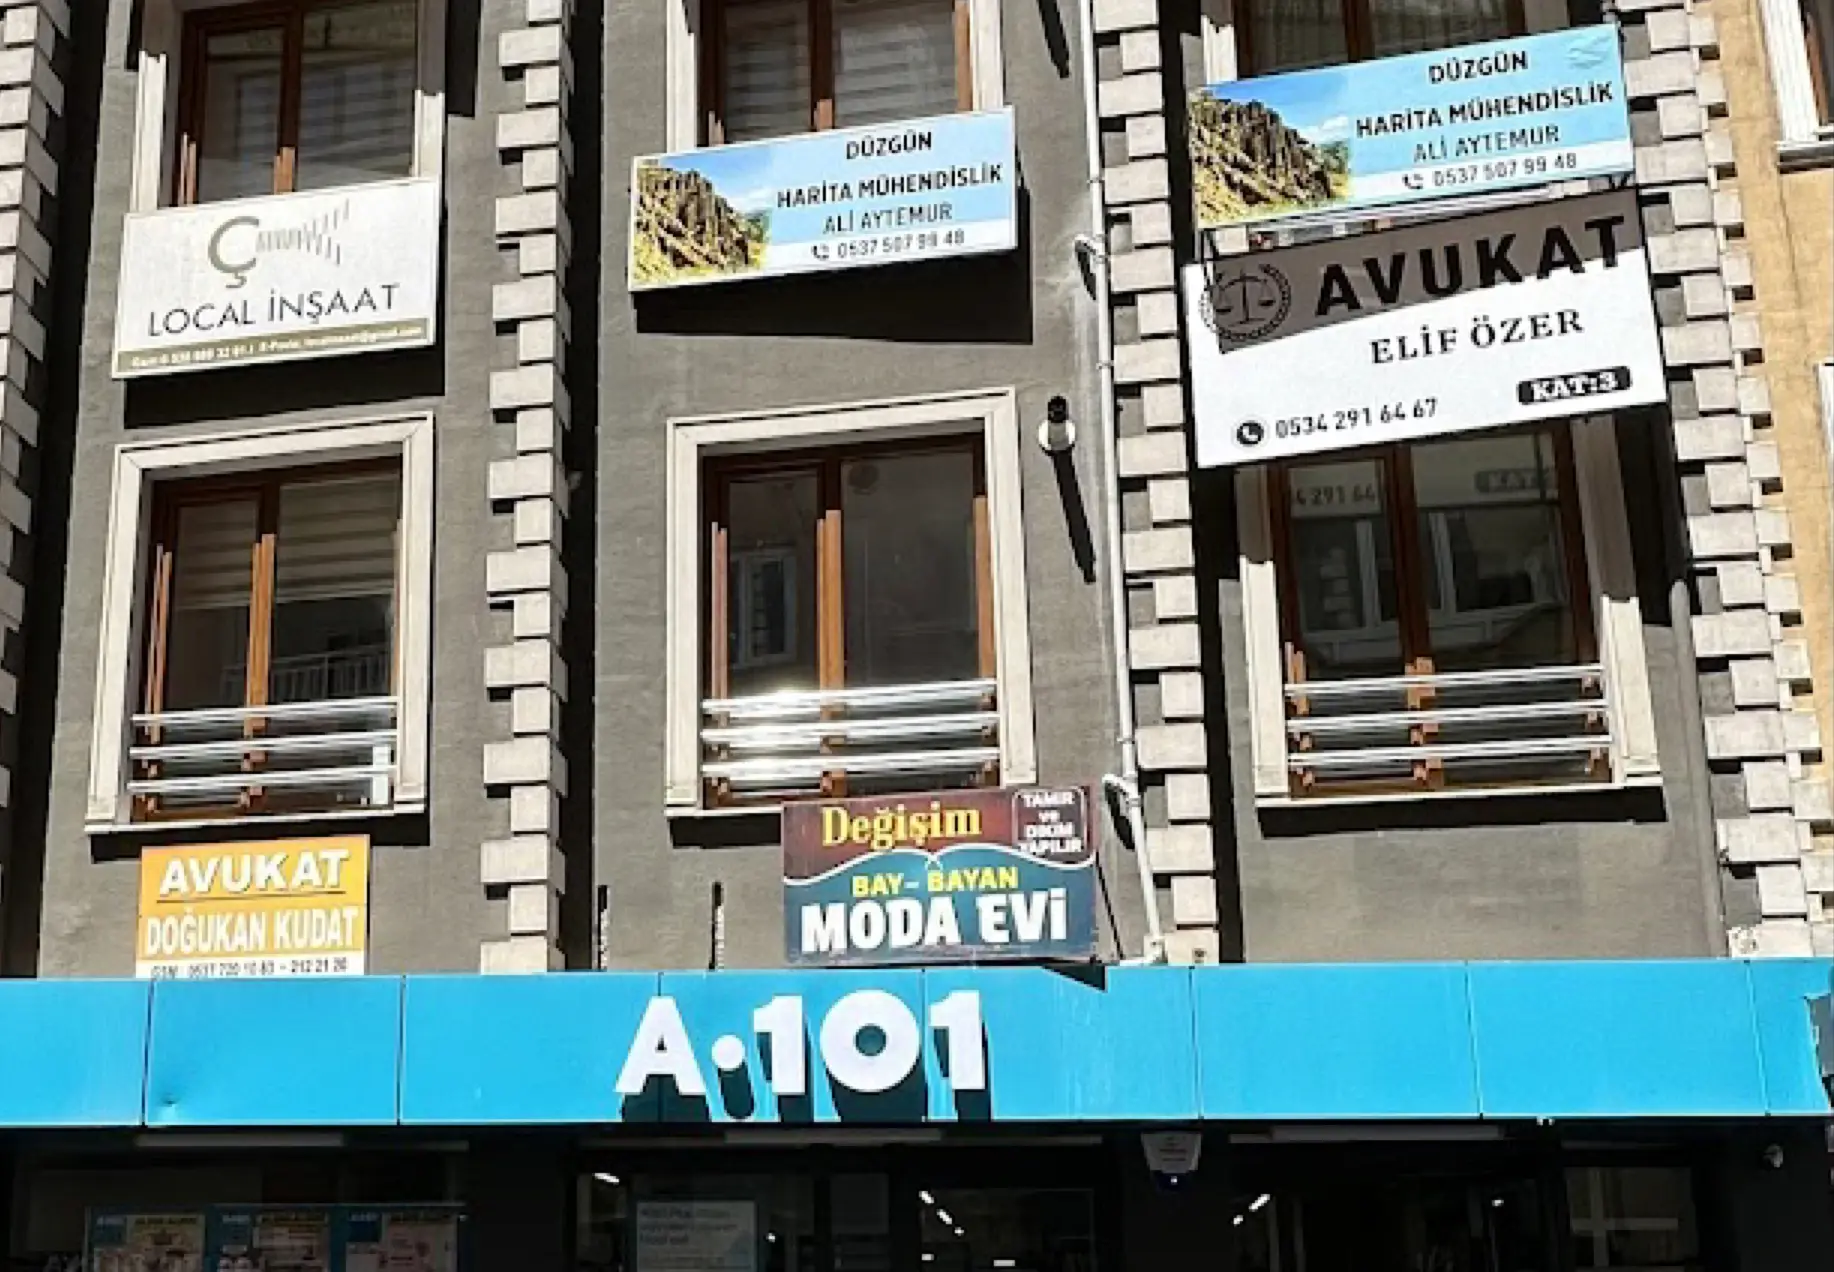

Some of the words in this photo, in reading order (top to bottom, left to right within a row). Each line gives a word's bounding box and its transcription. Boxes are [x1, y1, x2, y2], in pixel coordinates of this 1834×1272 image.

[1429, 50, 1529, 85] DÜZGÜN
[1356, 106, 1443, 138] HARİTA
[1448, 80, 1614, 126] MÜHENDİSLİK
[846, 131, 932, 160] DÜZGÜN
[1413, 137, 1447, 163] ALİ
[1456, 125, 1560, 160] AYTEMUR
[777, 178, 853, 208] HARİTA
[858, 161, 1004, 199] MÜHENDİSLİK
[1433, 165, 1477, 187] 0537
[1524, 155, 1547, 175] 99
[1554, 152, 1577, 169] 48
[822, 209, 855, 235] ALİ
[861, 202, 953, 230] AYTEMUR
[838, 239, 877, 258] 0537
[1314, 215, 1625, 317] AVUKAT
[149, 300, 255, 337] LOCAL
[267, 282, 400, 324] İNŞAAT
[1371, 325, 1458, 364] ELİF
[1469, 308, 1585, 348] ÖZER
[1528, 370, 1619, 402] KAT:3
[1275, 411, 1328, 439] 0534
[1334, 406, 1372, 431] 291
[1378, 401, 1406, 425] 64
[1412, 396, 1438, 419] 67
[822, 801, 982, 850] Değişim
[159, 849, 351, 897] AVUKAT
[928, 866, 1018, 892] BAYAN
[147, 905, 266, 956] DOĞUKAN
[274, 905, 359, 949] KUDAT
[801, 897, 961, 952] MODA
